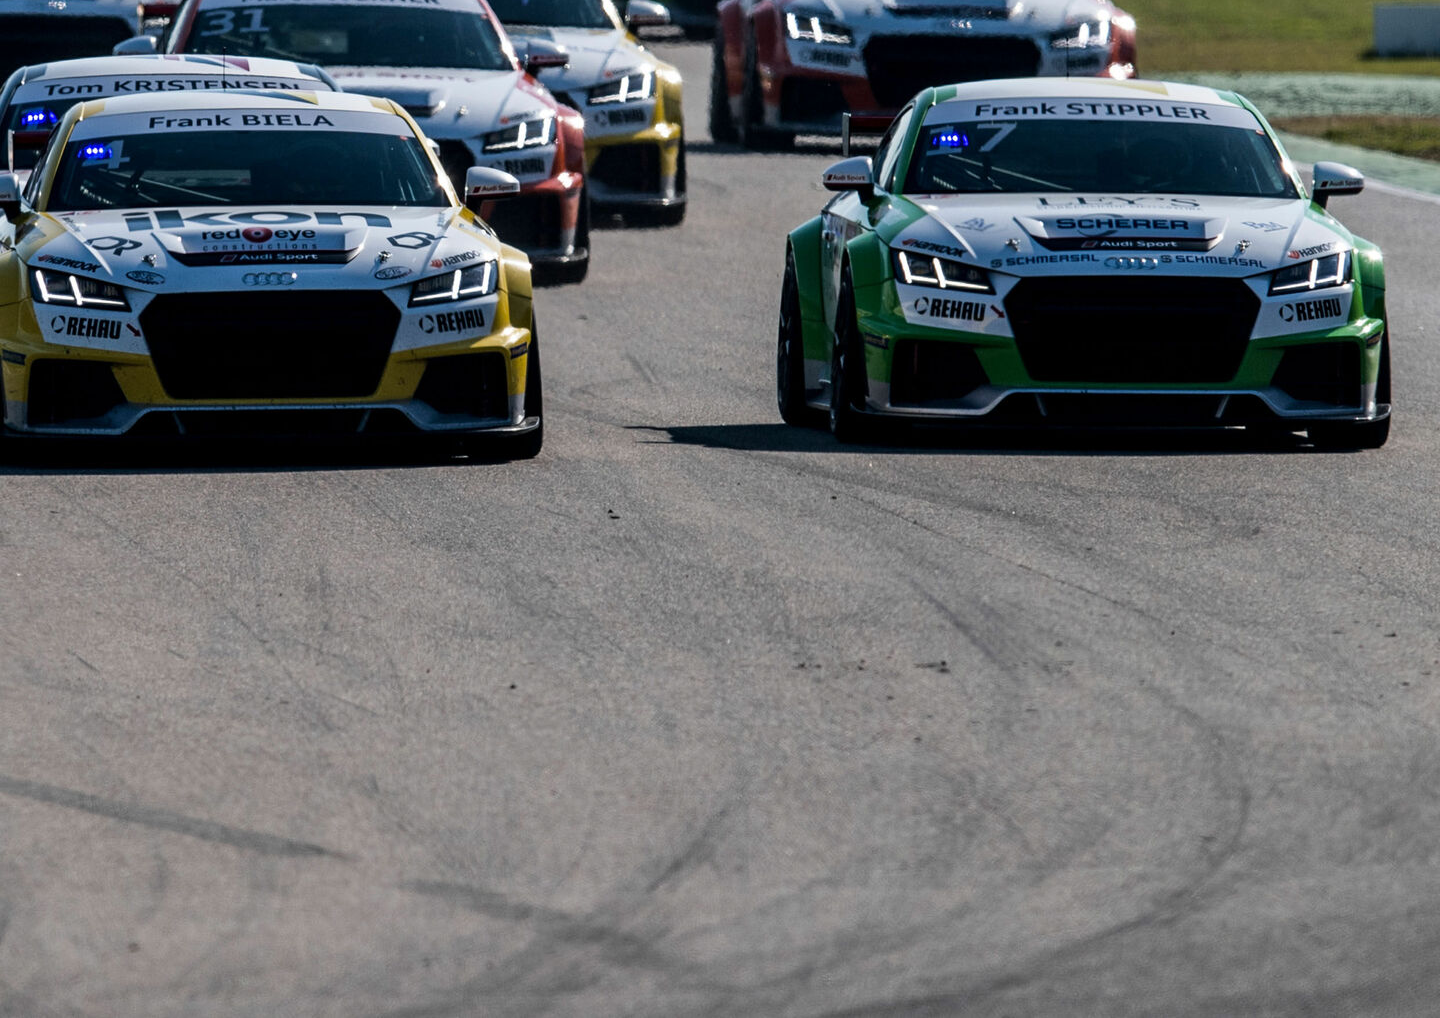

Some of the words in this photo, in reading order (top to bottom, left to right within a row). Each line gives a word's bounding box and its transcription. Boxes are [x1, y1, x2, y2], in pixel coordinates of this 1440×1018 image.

[200, 8, 271, 38] 31
[44, 82, 103, 96] Tom
[974, 101, 1056, 117] Frank
[1066, 101, 1212, 121] STIPPLER
[147, 114, 231, 129] Frank
[241, 114, 335, 128] BIELA
[121, 209, 394, 233] ikon
[1056, 217, 1190, 231] SCHERER
[201, 228, 241, 241] red
[274, 228, 316, 242] eye
[202, 242, 318, 253] constructions
[1099, 239, 1133, 249] Audi
[1135, 239, 1179, 251] Sport
[239, 252, 273, 262] Audi
[275, 252, 320, 264] Sport
[1005, 253, 1100, 267] SCHMERSAL
[1174, 254, 1268, 269] SCHMERSAL
[929, 297, 987, 322] REHAU
[1295, 297, 1343, 322] REHAU
[66, 316, 123, 340] REHAU
[435, 308, 486, 334] REHAU
